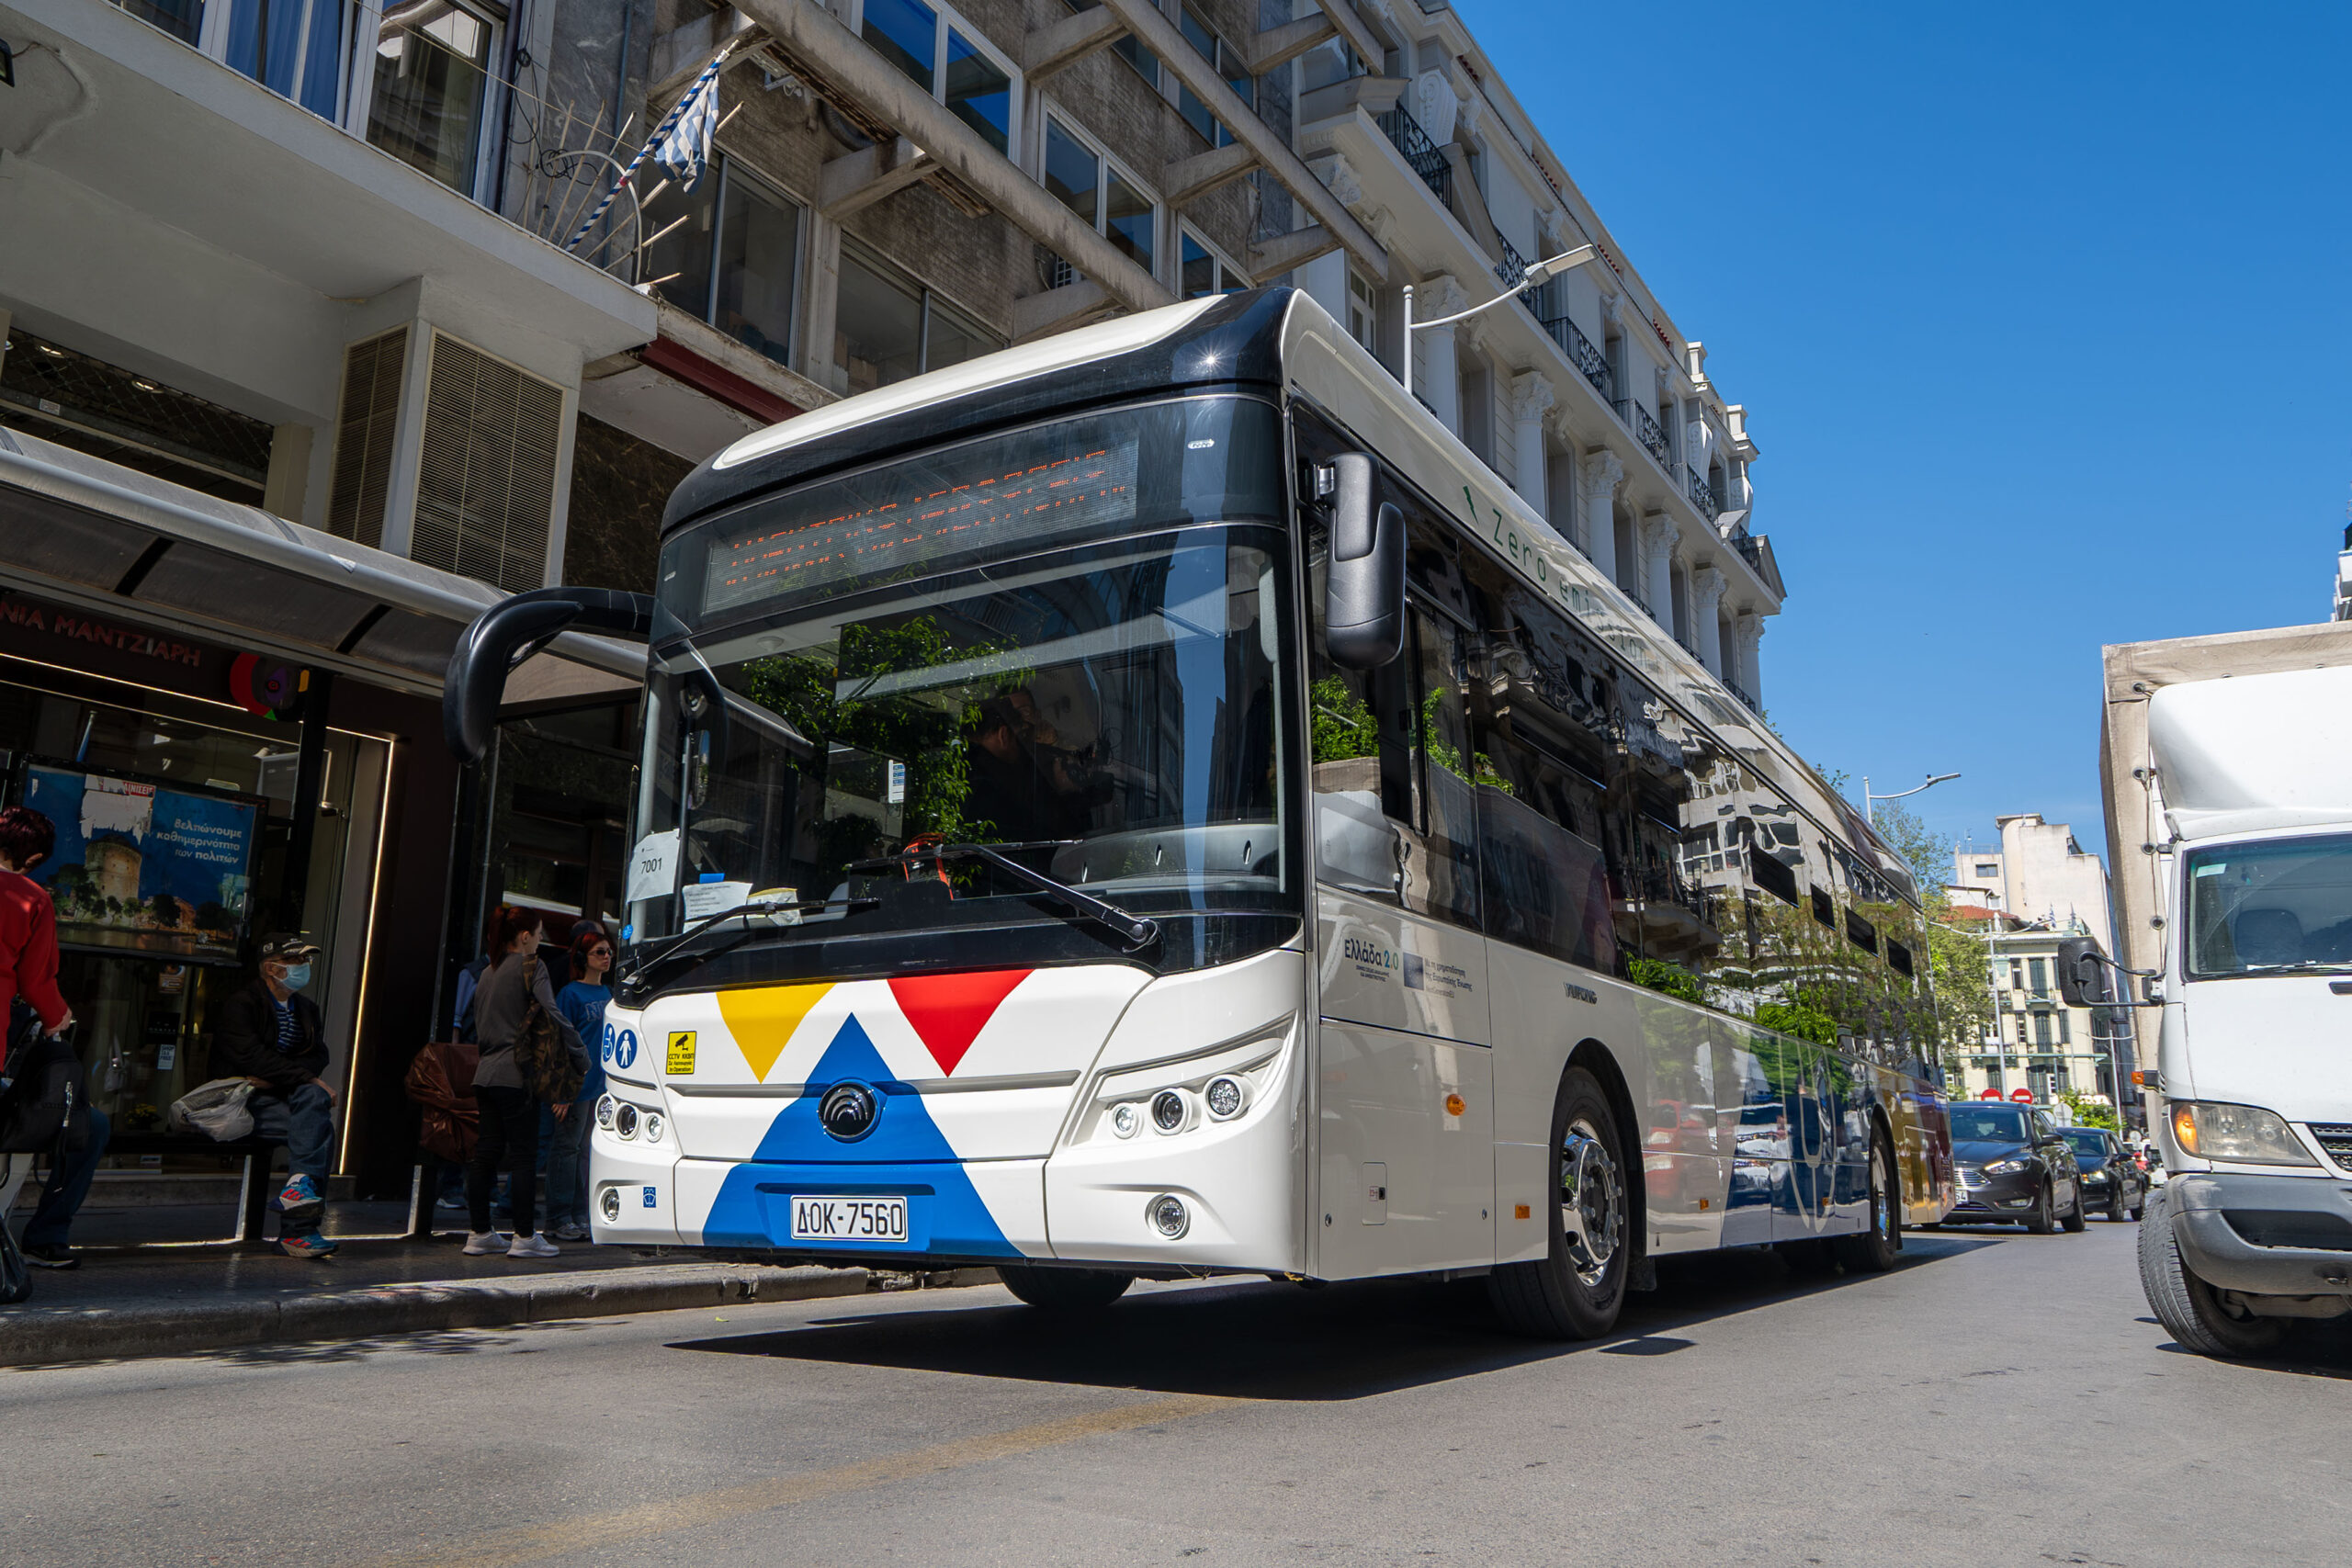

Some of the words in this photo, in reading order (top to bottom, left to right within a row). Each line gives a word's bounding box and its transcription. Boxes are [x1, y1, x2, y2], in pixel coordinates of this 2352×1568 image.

[1492, 508, 1547, 582] Zero
[54, 615, 202, 668] ΜΑΝΤΖΙΑΡΗ
[195, 850, 239, 864] πολιτών
[641, 857, 662, 874] 7001
[1344, 938, 1383, 966] Ελλάδα
[1384, 950, 1399, 971] 2.0
[797, 1201, 903, 1235] ΔΟΚ-7560
